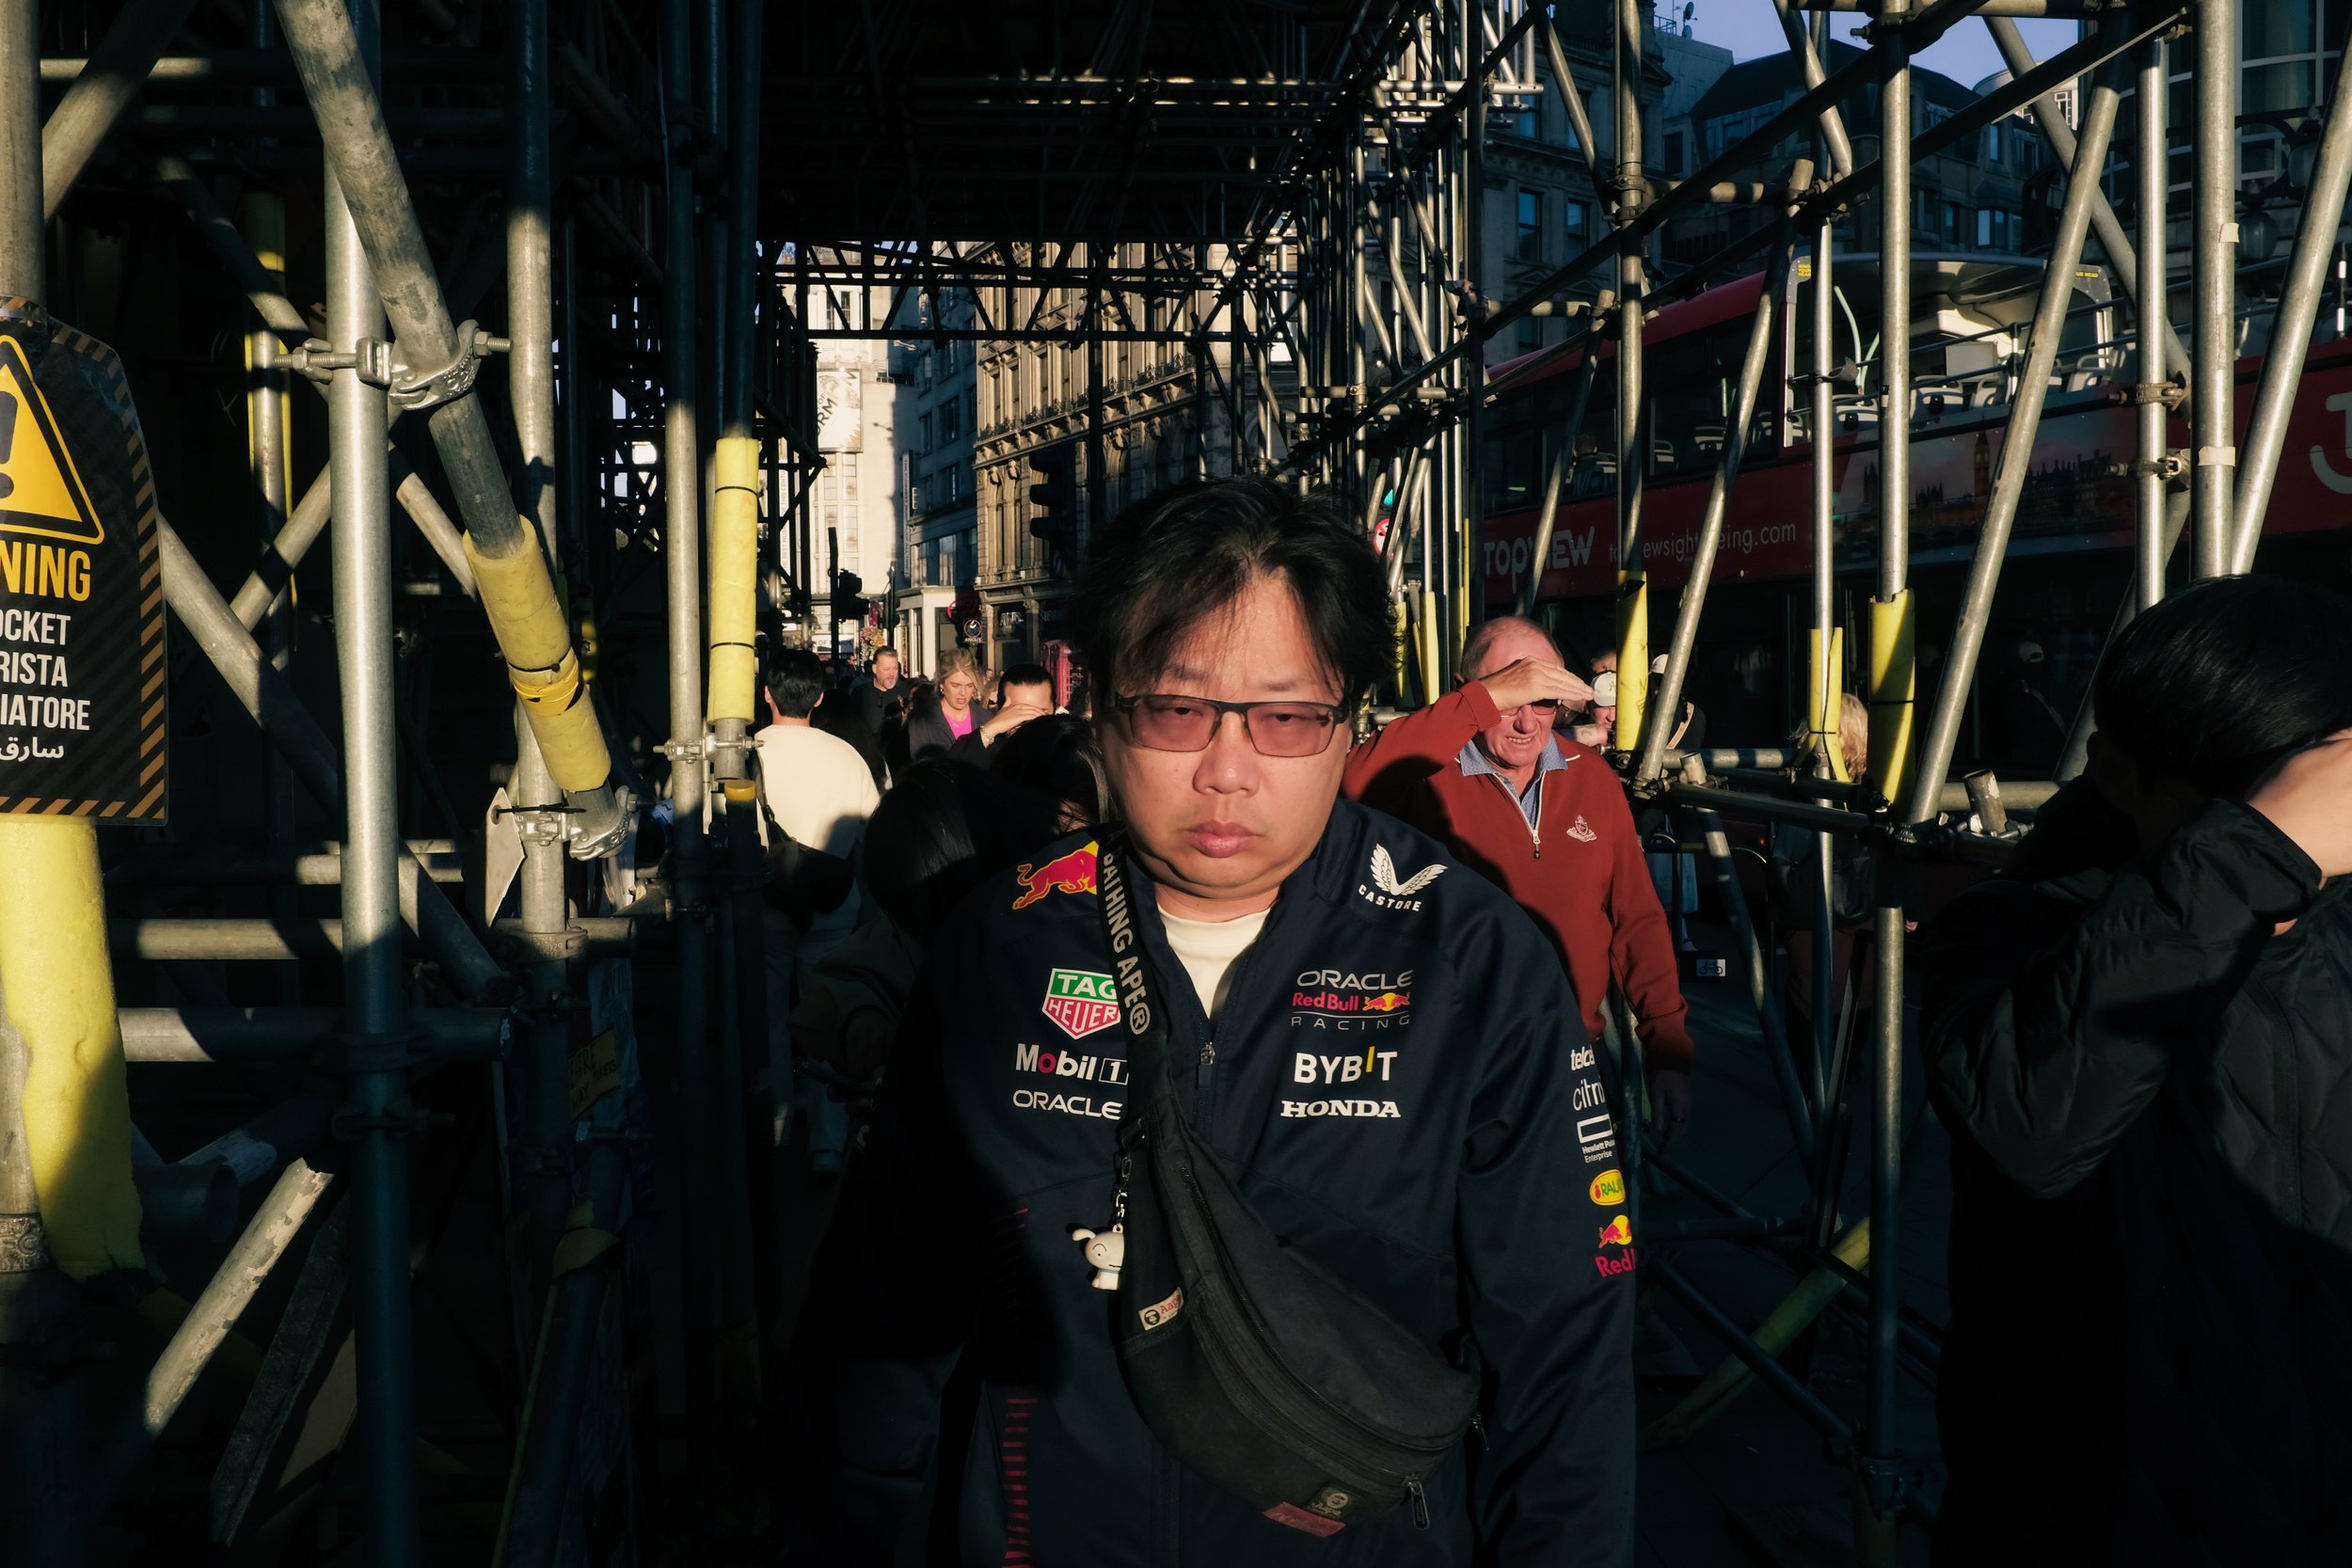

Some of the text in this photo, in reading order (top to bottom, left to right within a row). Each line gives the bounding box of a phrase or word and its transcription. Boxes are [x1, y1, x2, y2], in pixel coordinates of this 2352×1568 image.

[0, 693, 91, 731] IATORE
[1359, 883, 1422, 912] CASTORE
[1057, 974, 1118, 1000] TAG
[1295, 968, 1414, 990] ORACLE
[1047, 999, 1120, 1033] HEUER
[1291, 1014, 1410, 1031] RACING
[1015, 1042, 1097, 1082] Mobil
[1294, 1044, 1398, 1084] BYBIT
[1012, 1089, 1124, 1120] ORACLE
[1280, 1100, 1402, 1118] HONDA
[1584, 1149, 1613, 1164] Enterprise
